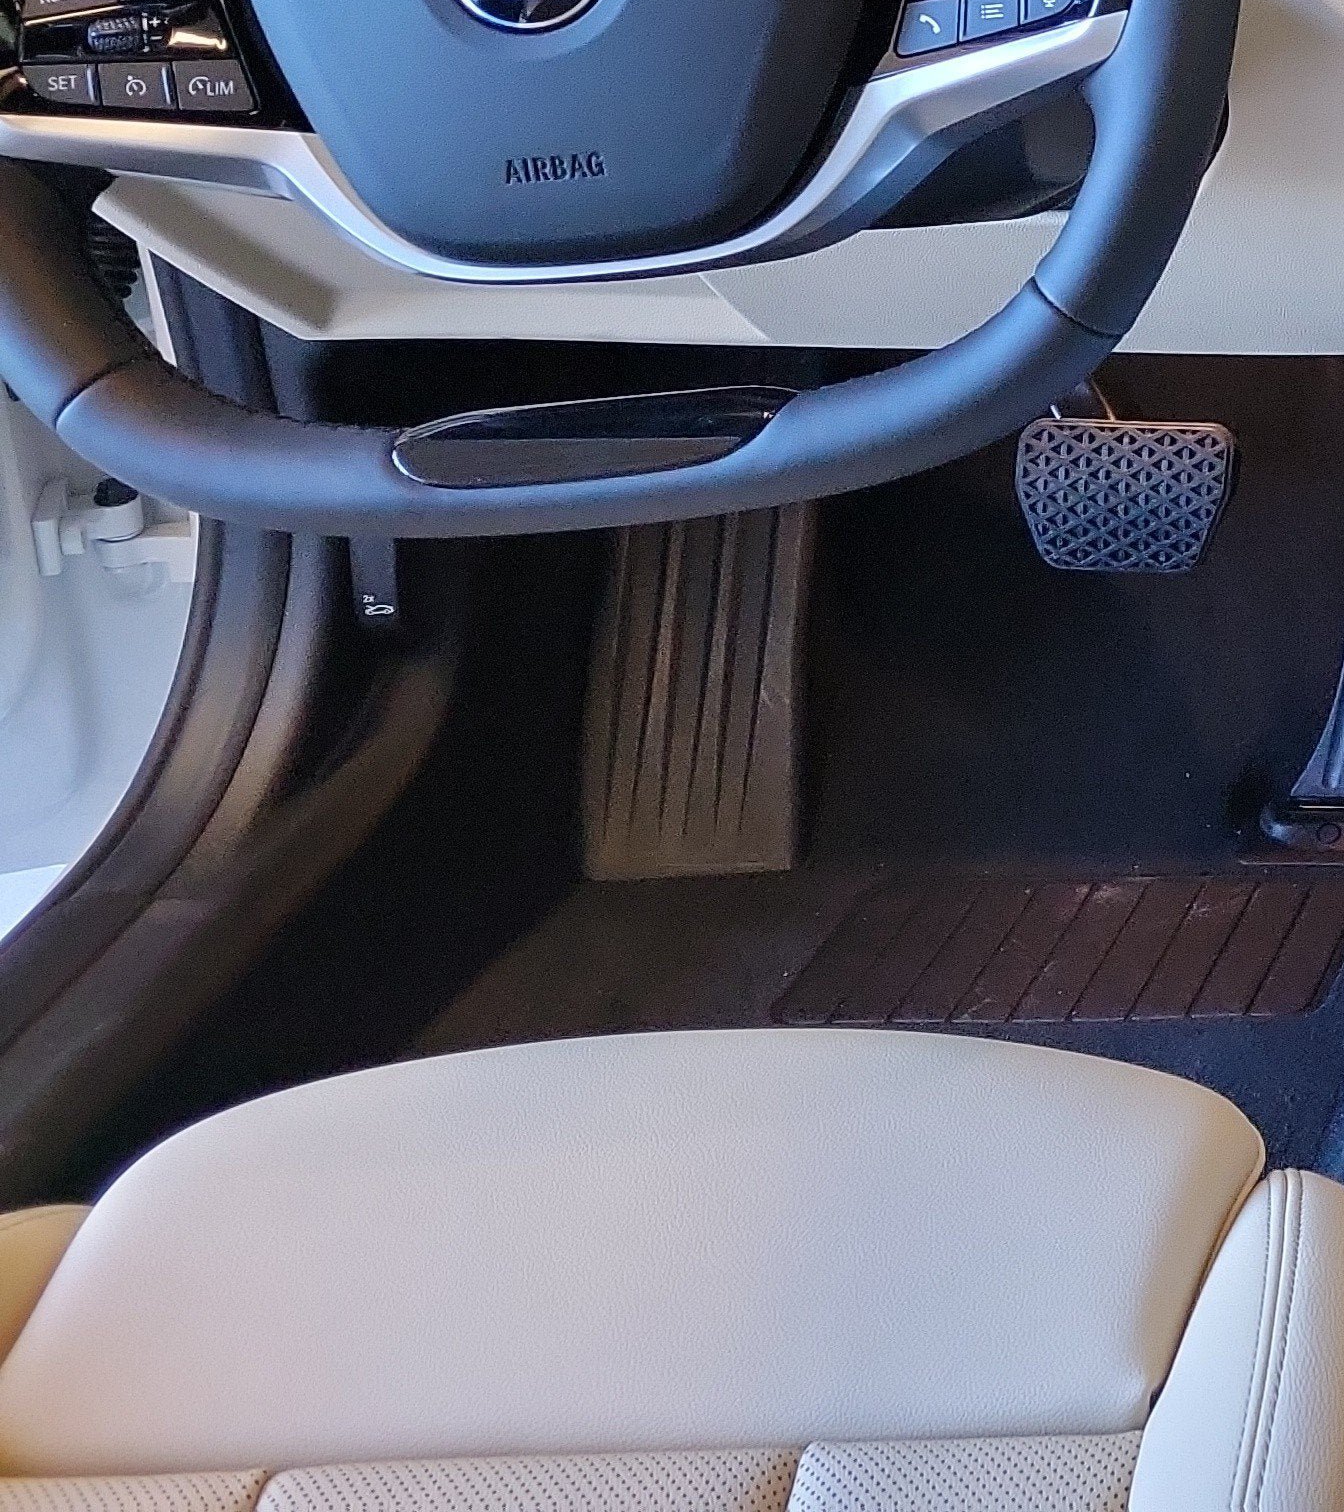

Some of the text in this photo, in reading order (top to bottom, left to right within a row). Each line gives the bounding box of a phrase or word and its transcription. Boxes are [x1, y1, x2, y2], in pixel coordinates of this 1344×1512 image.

[48, 75, 77, 91] SET
[206, 80, 234, 96] LIM
[504, 150, 607, 187] AIRBAG
